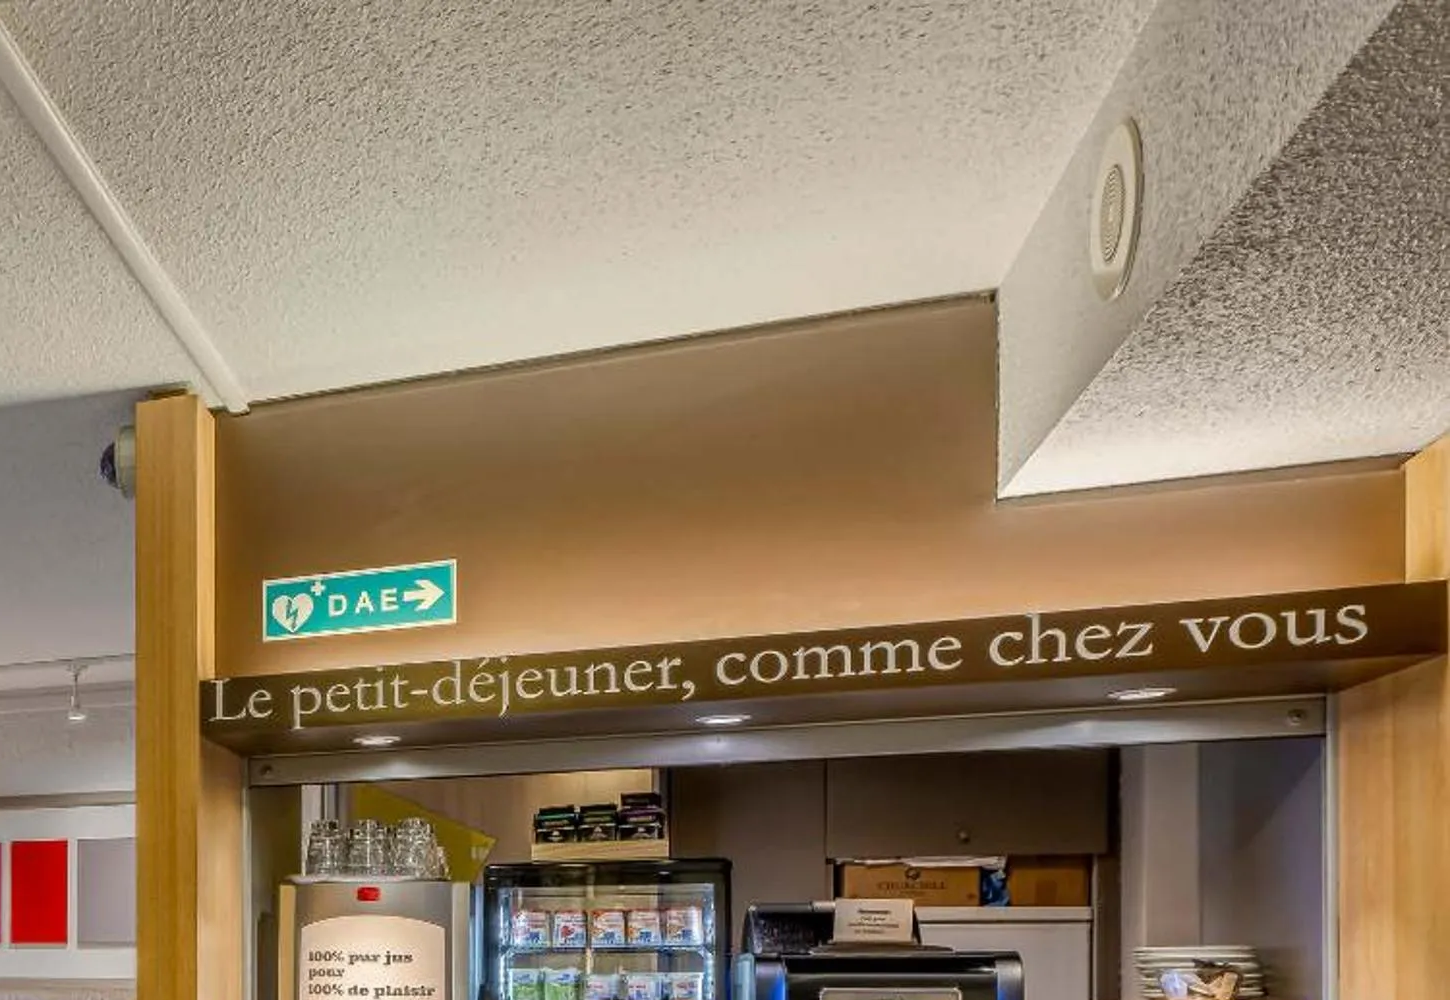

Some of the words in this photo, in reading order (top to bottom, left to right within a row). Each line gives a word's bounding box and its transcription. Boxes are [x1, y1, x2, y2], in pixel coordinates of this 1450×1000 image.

[328, 587, 399, 617] DAE
[209, 677, 274, 722] Le
[291, 653, 696, 730] petit-déjeuner,
[715, 635, 963, 686] comme
[988, 610, 1155, 668] chez
[1180, 603, 1369, 654] vous
[308, 951, 345, 962] 100%
[383, 950, 413, 966] jus
[308, 967, 345, 981] pour
[308, 983, 345, 996] 100%
[348, 985, 370, 996] de
[373, 984, 436, 999] plaisir
